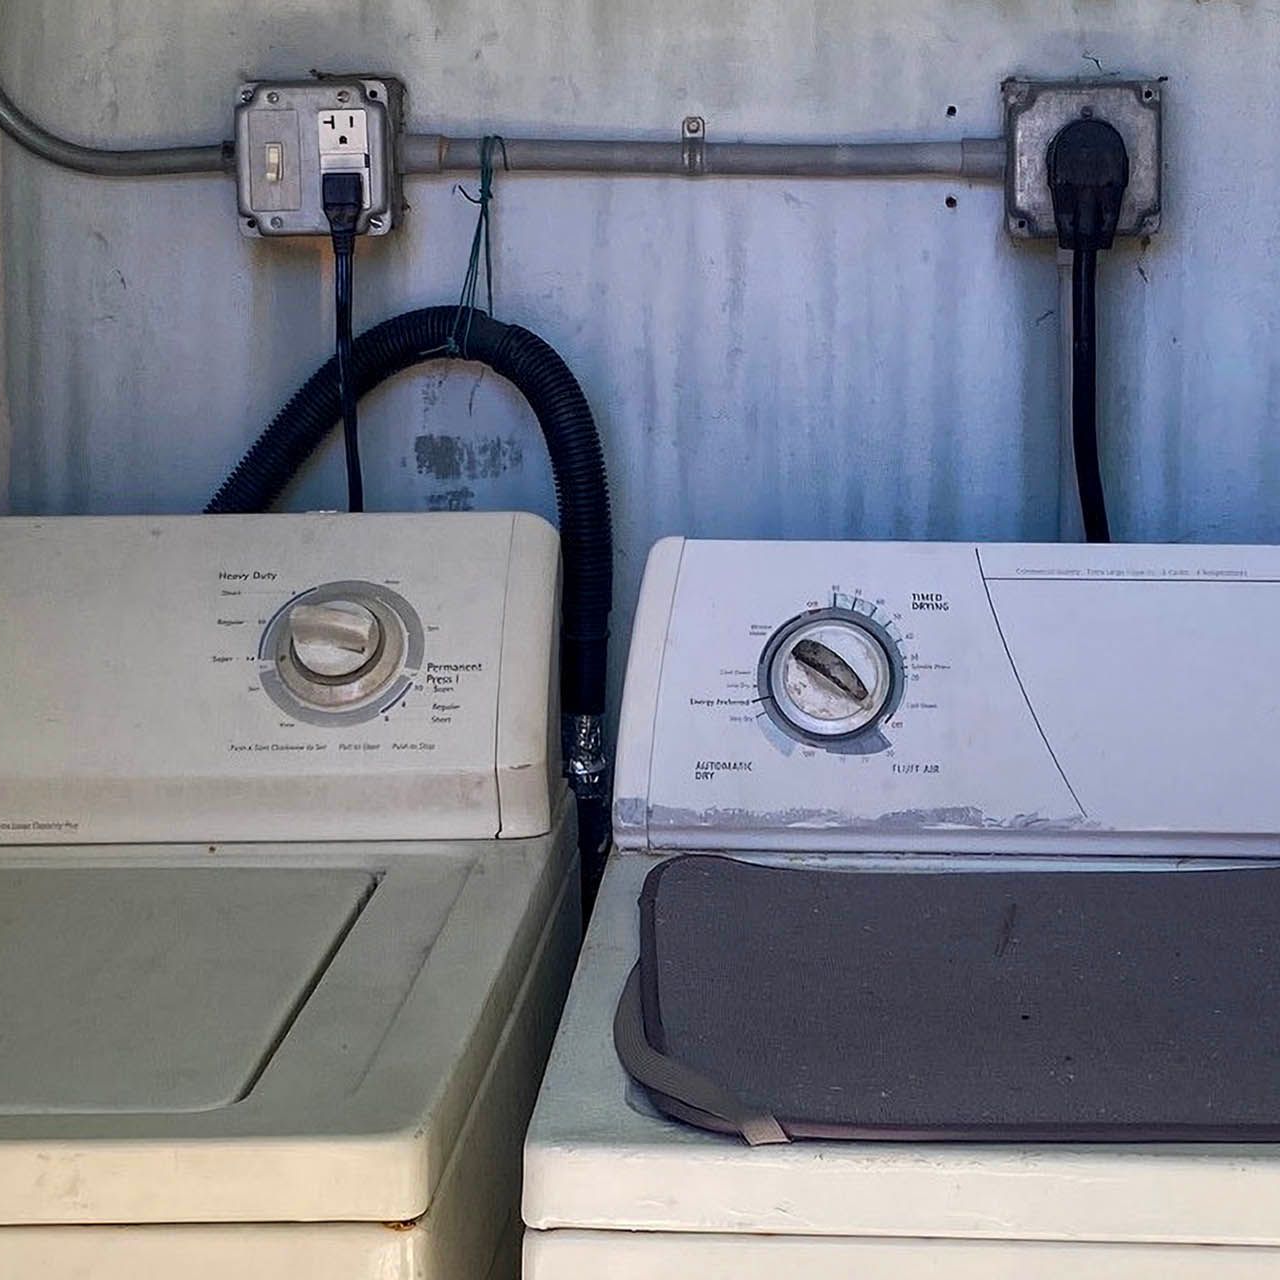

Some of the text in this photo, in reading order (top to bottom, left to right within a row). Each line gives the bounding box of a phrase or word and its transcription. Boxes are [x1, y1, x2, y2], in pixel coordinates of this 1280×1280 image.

[218, 570, 278, 581] Heavy Duty
[911, 592, 943, 602] TIMED
[911, 601, 950, 612] DRYING
[426, 662, 482, 673] Permanent
[426, 673, 453, 684] Press
[694, 760, 753, 771] AUTOMATIC
[922, 763, 940, 774] AIR
[695, 771, 716, 780] DRY
